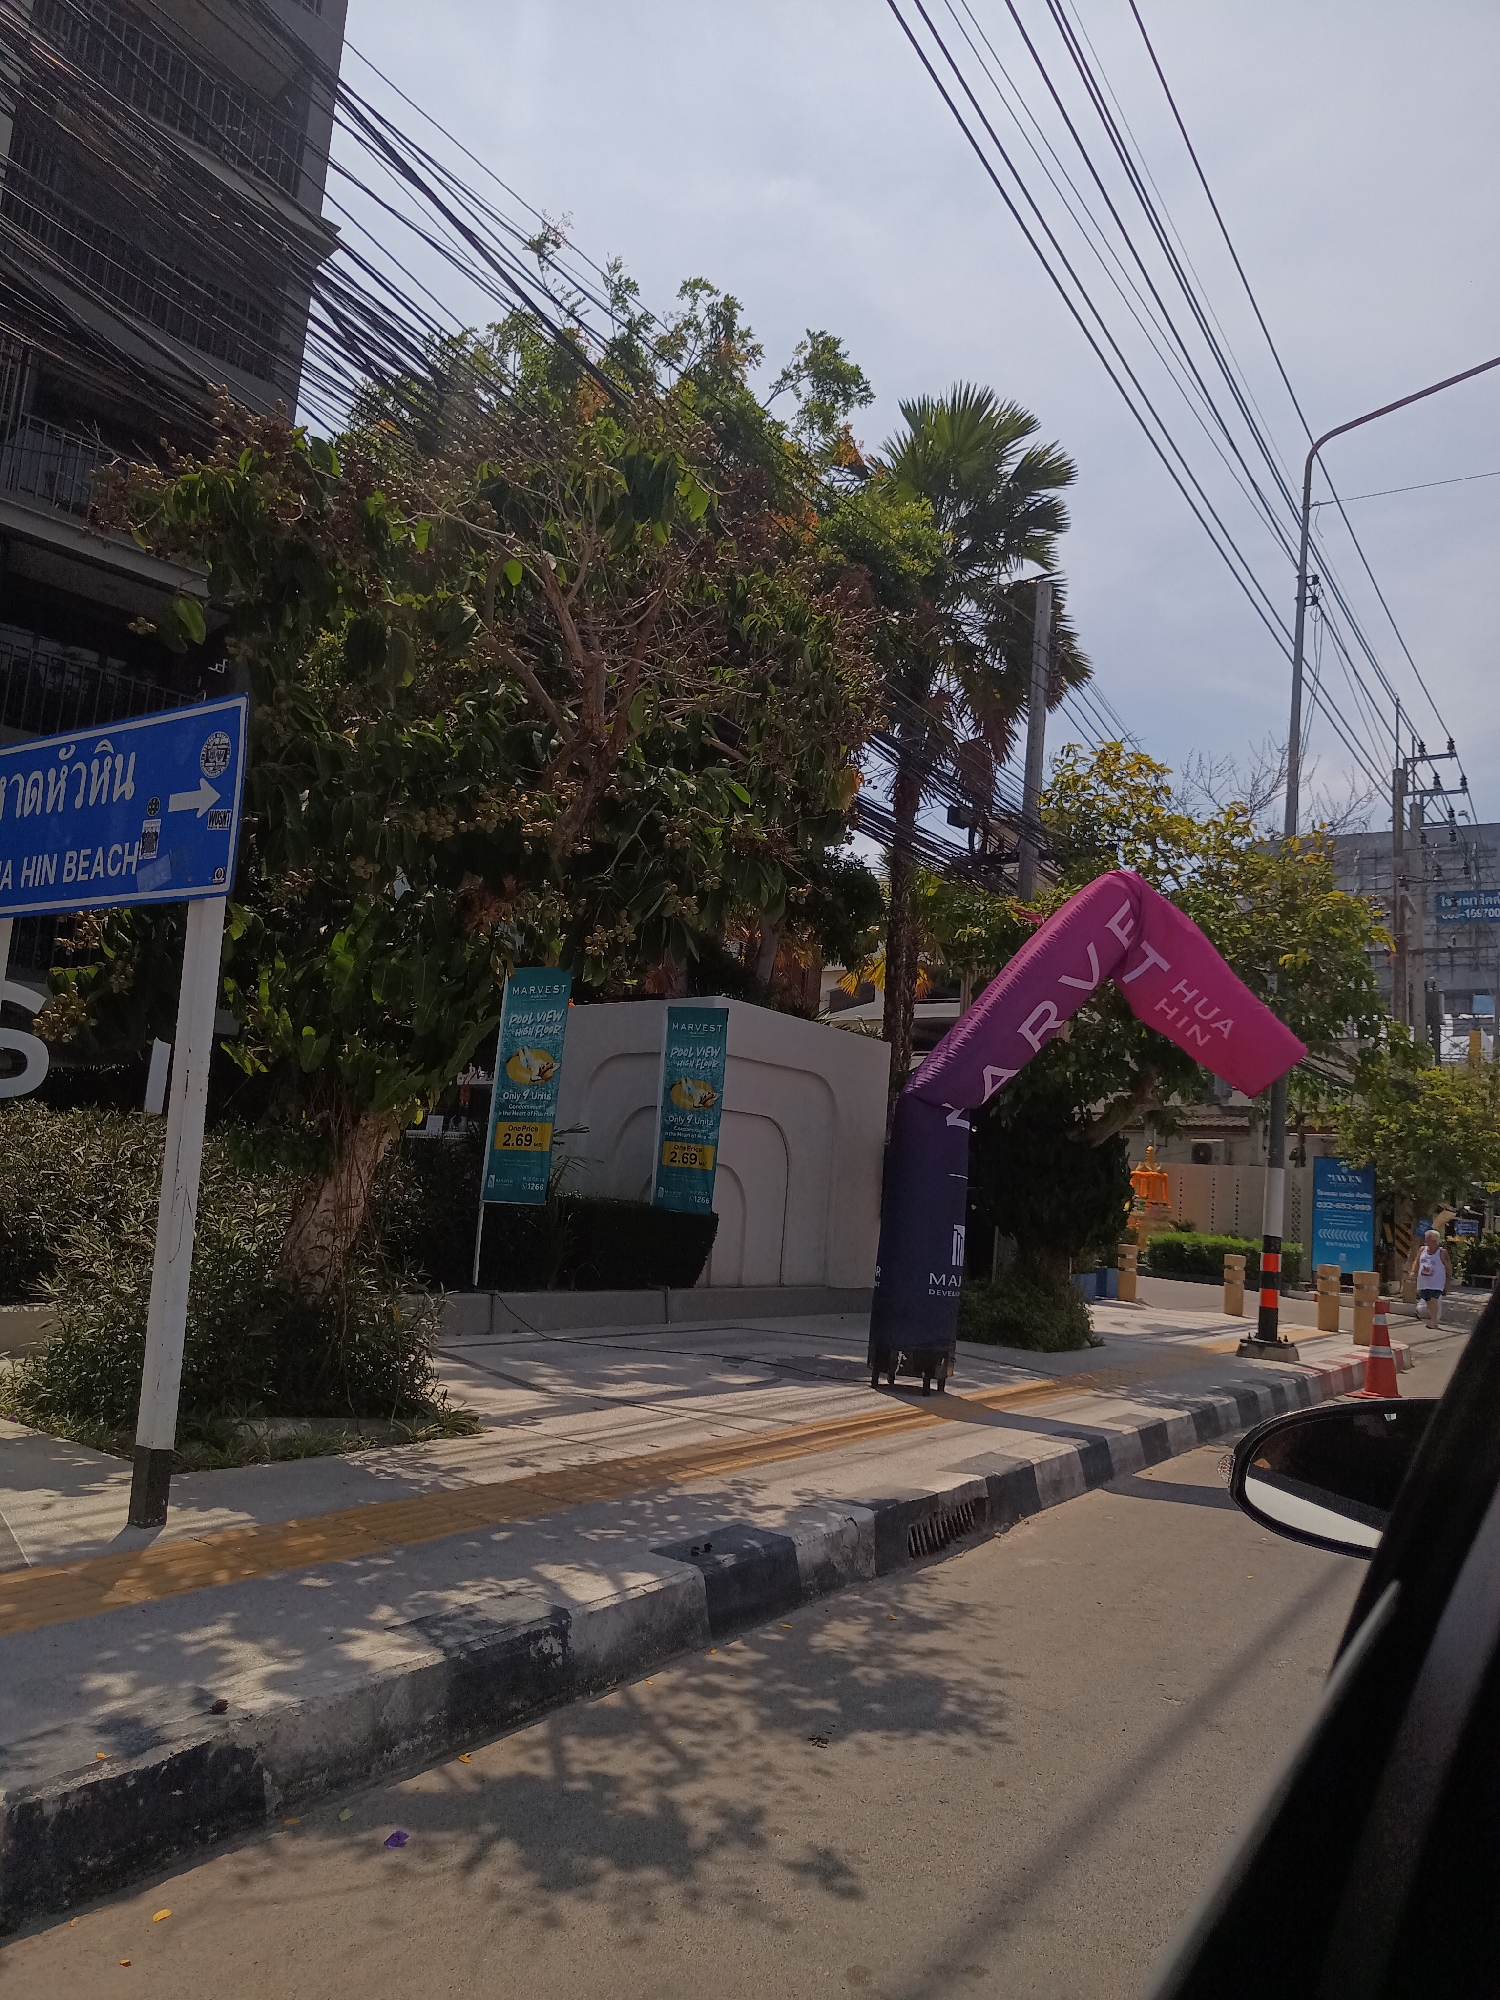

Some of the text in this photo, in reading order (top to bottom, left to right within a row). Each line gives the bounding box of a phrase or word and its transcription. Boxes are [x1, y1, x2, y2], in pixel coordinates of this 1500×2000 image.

[0, 841, 140, 891] A HIN BEACH
[512, 984, 567, 996] MARVEST
[1170, 979, 1234, 1040] HUA
[508, 1009, 565, 1026] POOL VIEW
[1153, 998, 1212, 1047] HIN
[514, 1025, 562, 1038] HIGH FLOOR
[672, 1022, 723, 1032] MARVEST
[670, 1045, 721, 1058] POOL VIEW
[502, 1089, 552, 1102] Only 9 Units
[668, 1113, 714, 1126] Only 9 Units
[502, 1132, 533, 1147] 2.69
[669, 1151, 698, 1165] 2.69
